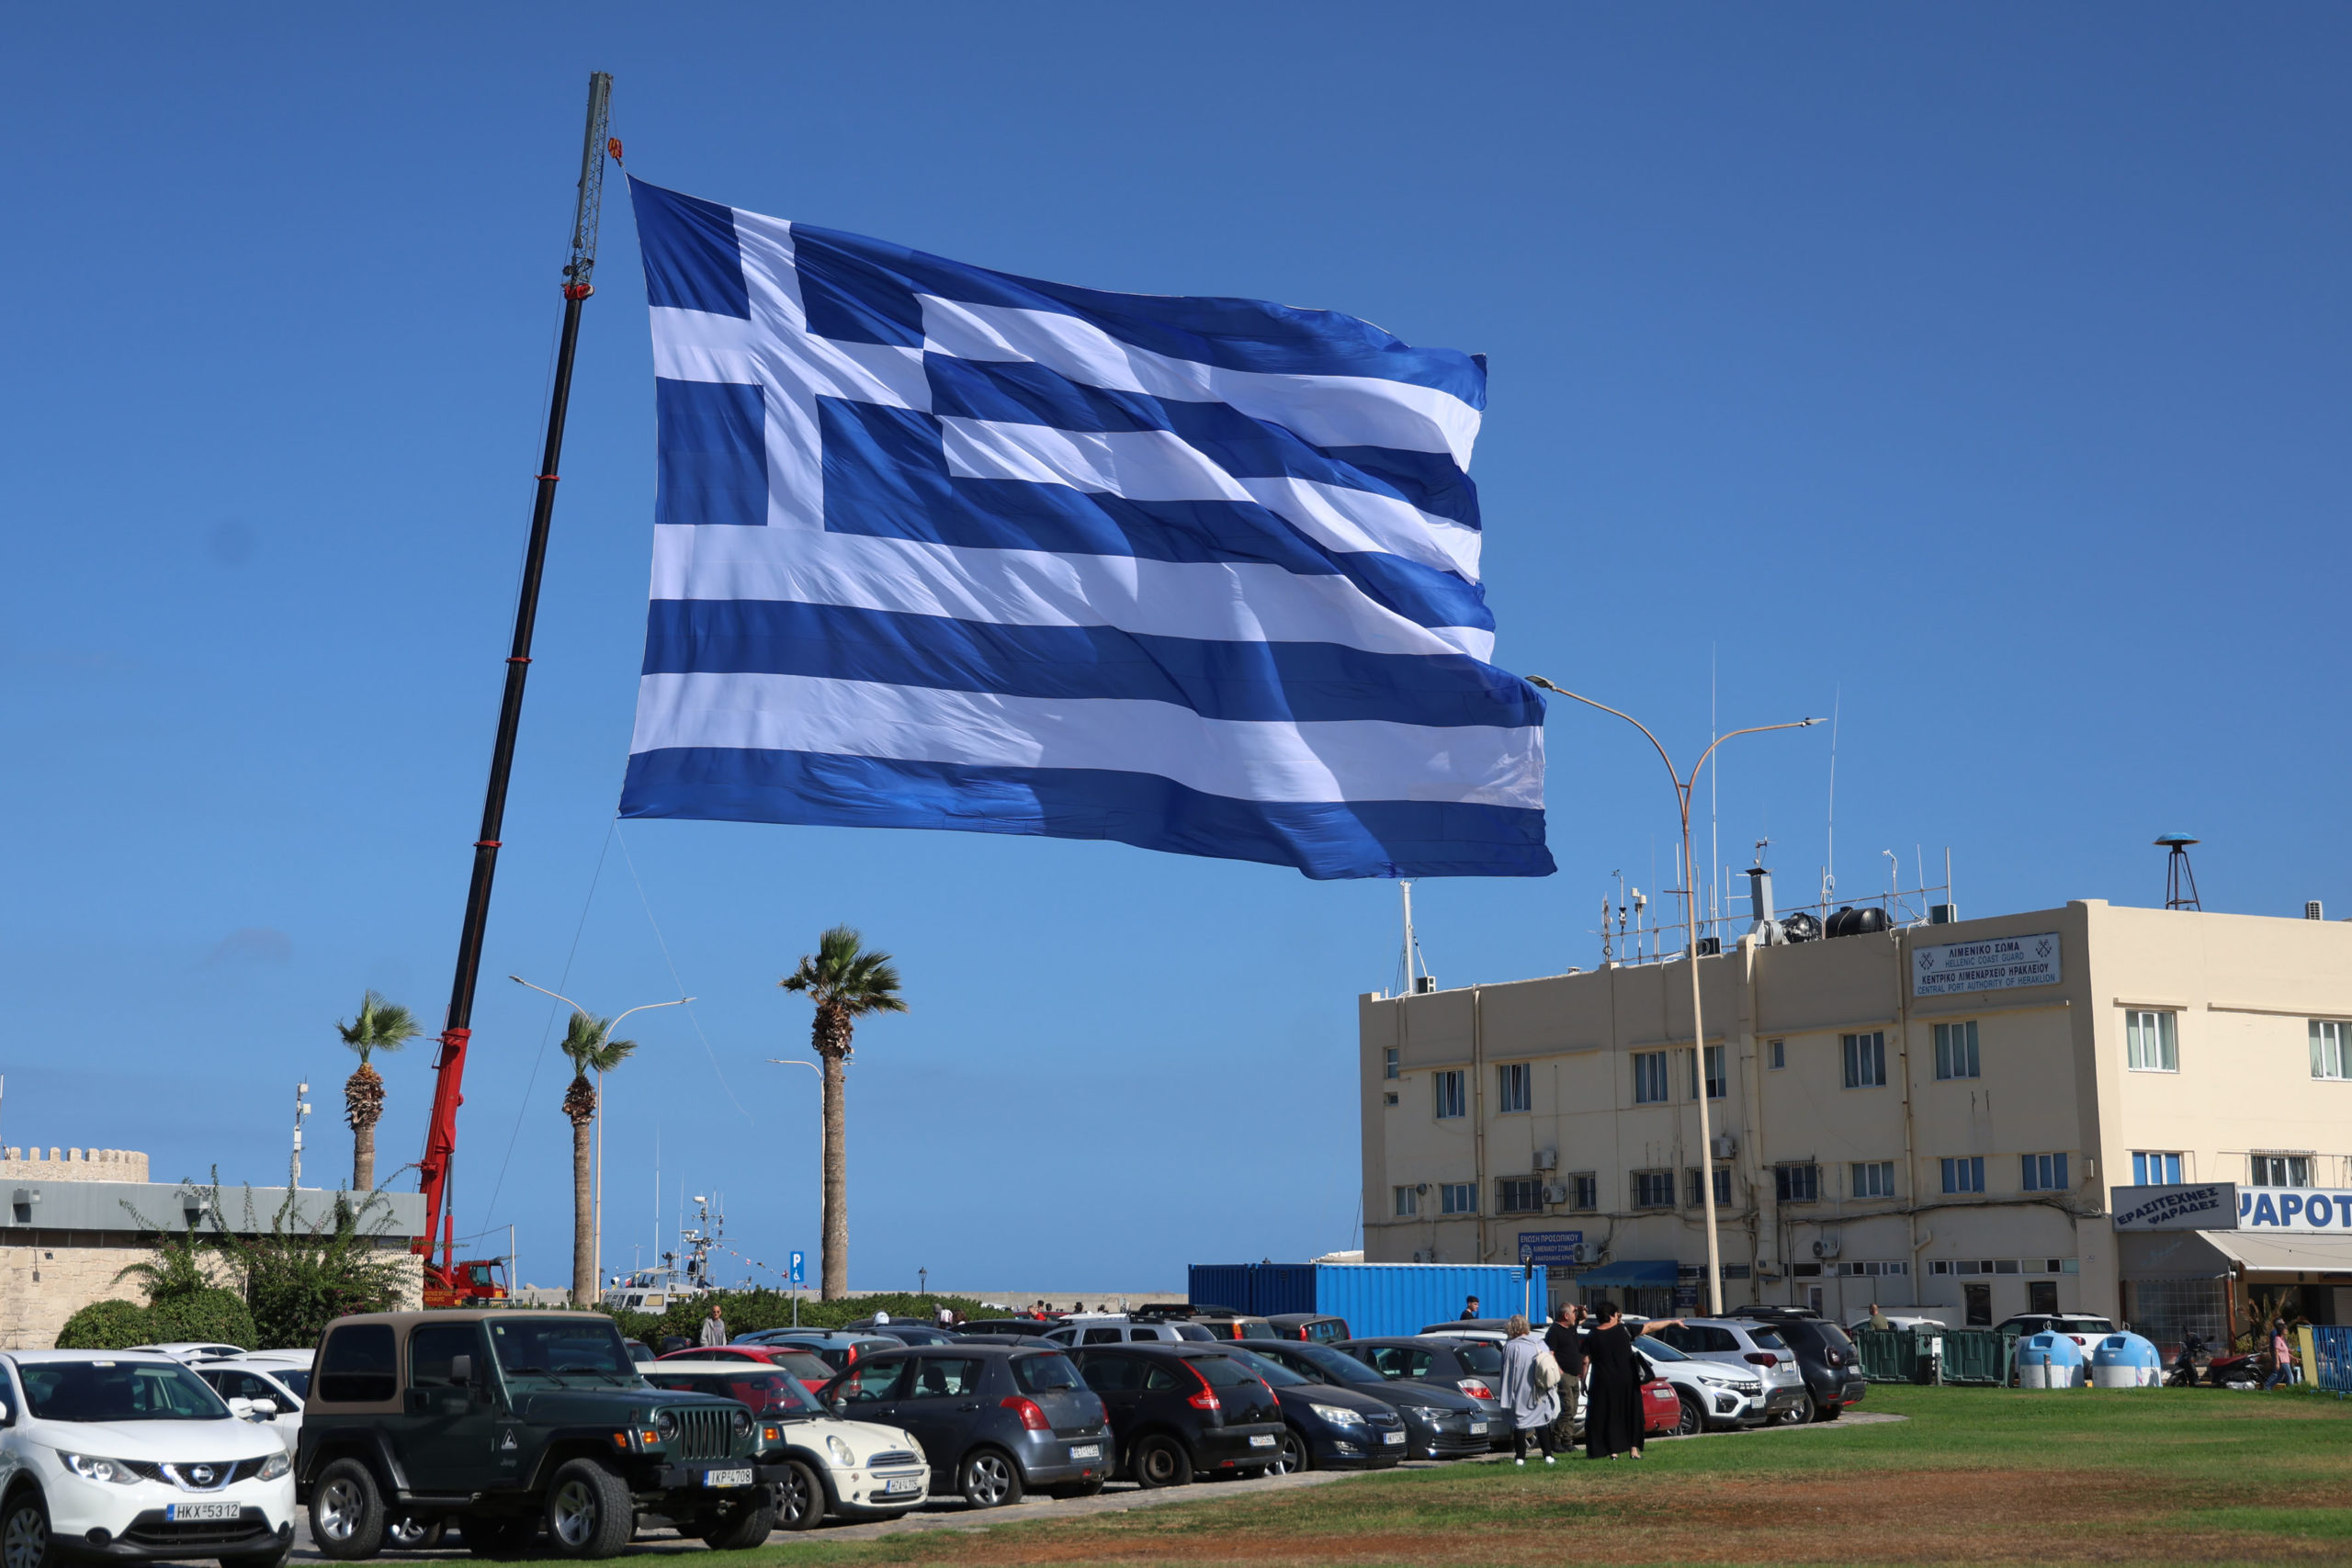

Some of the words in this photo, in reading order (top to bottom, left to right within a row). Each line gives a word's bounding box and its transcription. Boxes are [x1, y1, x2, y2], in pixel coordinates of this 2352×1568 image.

[1949, 945, 1991, 958] ΛΙΜΕΝΙΚΟ
[1995, 942, 2019, 953] ΣΩΜΑ
[1945, 956, 1974, 968] HELLENIC
[1978, 954, 1998, 964] COAST
[2001, 952, 2024, 962] GUARD
[1922, 973, 1955, 985] ΚΕΝΤΡΙΚΟ
[1958, 966, 2006, 981] ΛΙΜΕΝΑΡΧΕΙΟ
[2008, 963, 2049, 976] ΗΡΑΚΛΕΙΟΥ
[1917, 984, 1945, 995] CENTRAL
[1948, 983, 1964, 992] PORT
[1967, 978, 2002, 990] AUTHORITY
[2006, 977, 2015, 987] OF
[2018, 974, 2056, 986] HERAKLION
[2117, 1187, 2219, 1225] ΕΡΑΣΙΤΕΧΝΕΣ
[2147, 1200, 2220, 1224] ΨΑΡΑΔΕΣ
[1541, 1234, 1578, 1243] ΠΡΟΣΩΠΙΚΟΥ
[794, 1254, 801, 1268] P
